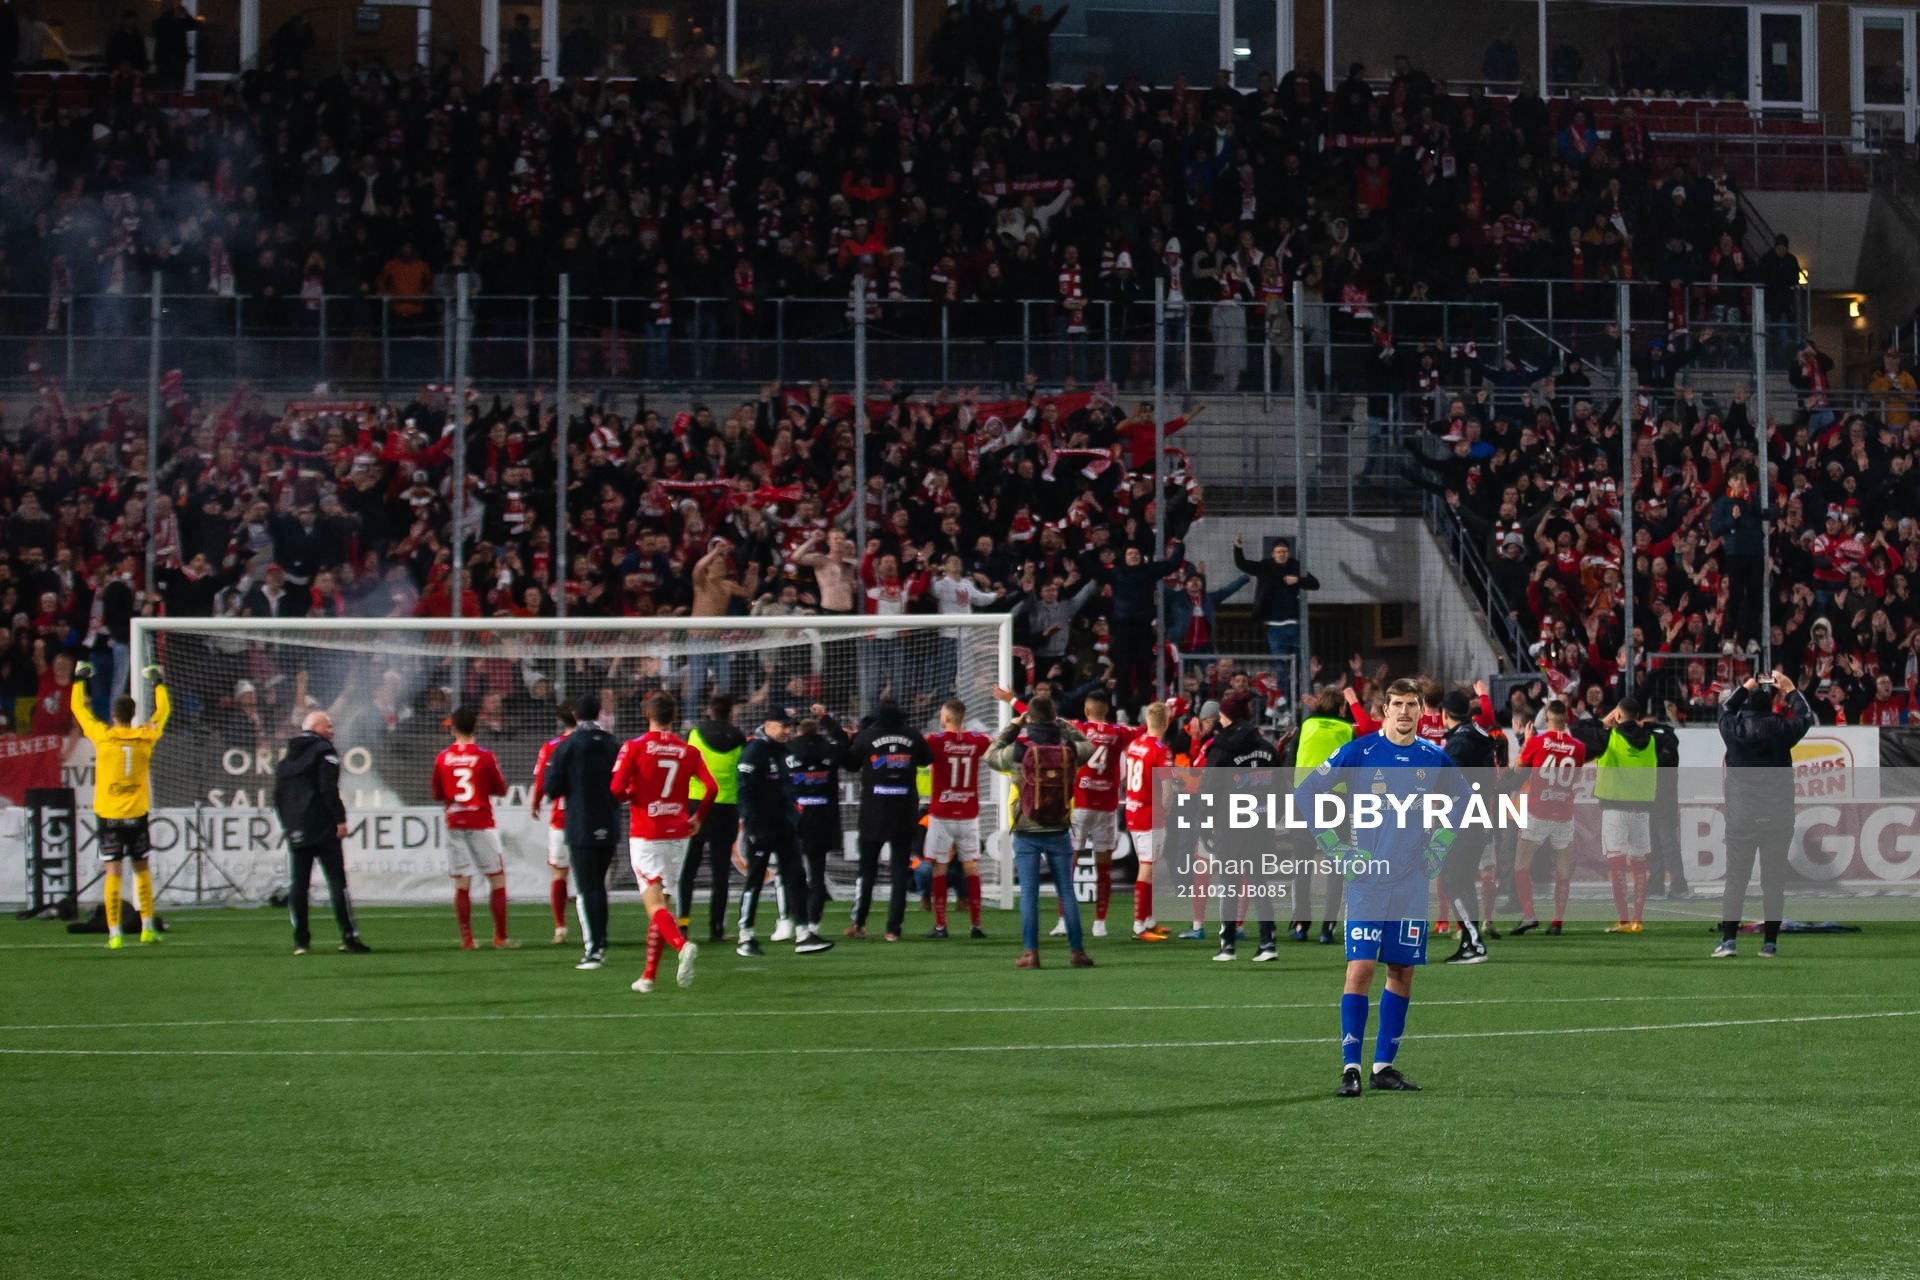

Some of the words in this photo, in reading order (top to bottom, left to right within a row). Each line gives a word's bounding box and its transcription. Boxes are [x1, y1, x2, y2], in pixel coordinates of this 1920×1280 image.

[121, 745, 133, 778] 1
[947, 756, 972, 788] 11
[1087, 745, 1108, 775] 4
[1126, 758, 1144, 792] 18
[1538, 754, 1576, 788] 40
[1793, 757, 1847, 779] RÖDS
[453, 768, 476, 802] 3
[657, 759, 680, 799] 7
[1794, 773, 1847, 798] ARN
[344, 815, 440, 850] MEDI
[1680, 804, 1920, 882] BGG
